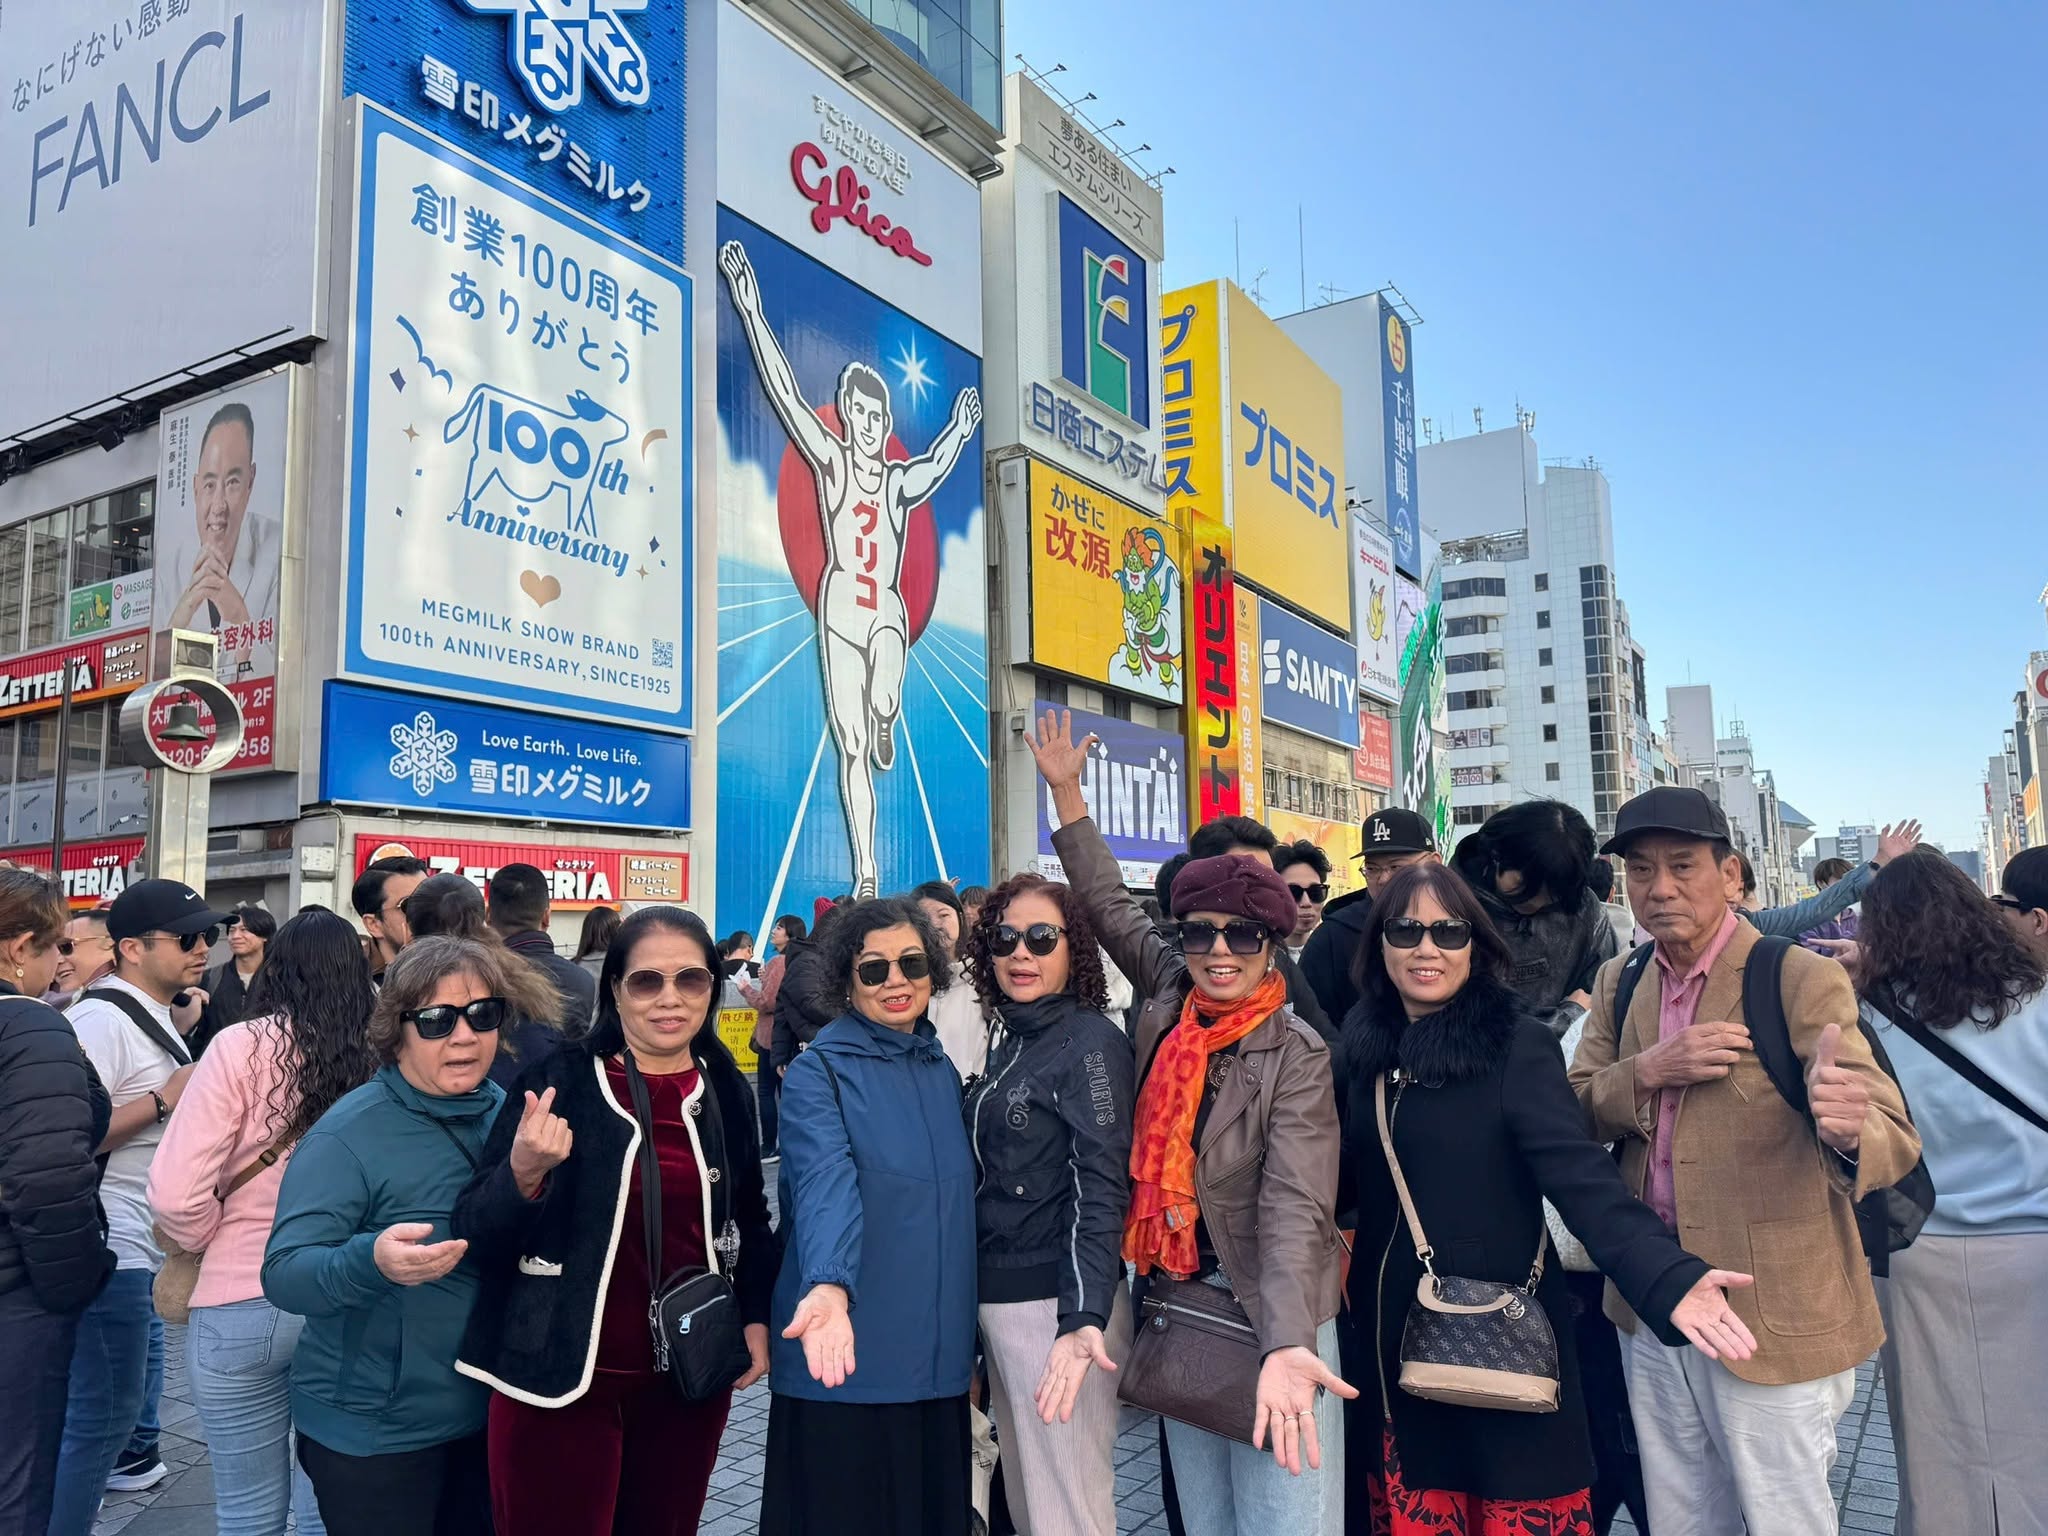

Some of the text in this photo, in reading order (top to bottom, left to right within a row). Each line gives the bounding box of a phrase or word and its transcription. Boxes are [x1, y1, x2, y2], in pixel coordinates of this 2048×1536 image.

[28, 13, 271, 228] FANCL
[421, 52, 651, 213] 雪印メグミルク
[821, 121, 904, 196] ゆたかな人生
[791, 141, 933, 267] Glico
[1048, 140, 1144, 237] エステムシリーズ
[410, 182, 660, 337] 創業100周年
[448, 270, 630, 384] ありがとう
[1031, 381, 1167, 493] 日商エステム
[1161, 303, 1199, 499] プロミス
[488, 399, 630, 495] 100th
[1240, 401, 1339, 530] プロミス
[446, 495, 630, 578] Anniversary
[1044, 513, 1112, 580] 改源
[1051, 482, 1105, 531] かぜに
[851, 499, 880, 611] グリコ
[379, 622, 434, 649] 100th
[421, 597, 640, 660] MEGMILK SNOW BRAND
[253, 686, 273, 708] 2F
[1202, 543, 1231, 818] オリエント
[1285, 648, 1356, 715] SAMTY
[469, 758, 651, 807] 雪印メグミルク
[482, 729, 642, 766] Love Earth. Love Life.
[1373, 817, 1391, 842] LA
[645, 886, 678, 896] コーヒー
[1083, 1050, 1116, 1127] SPORTS
